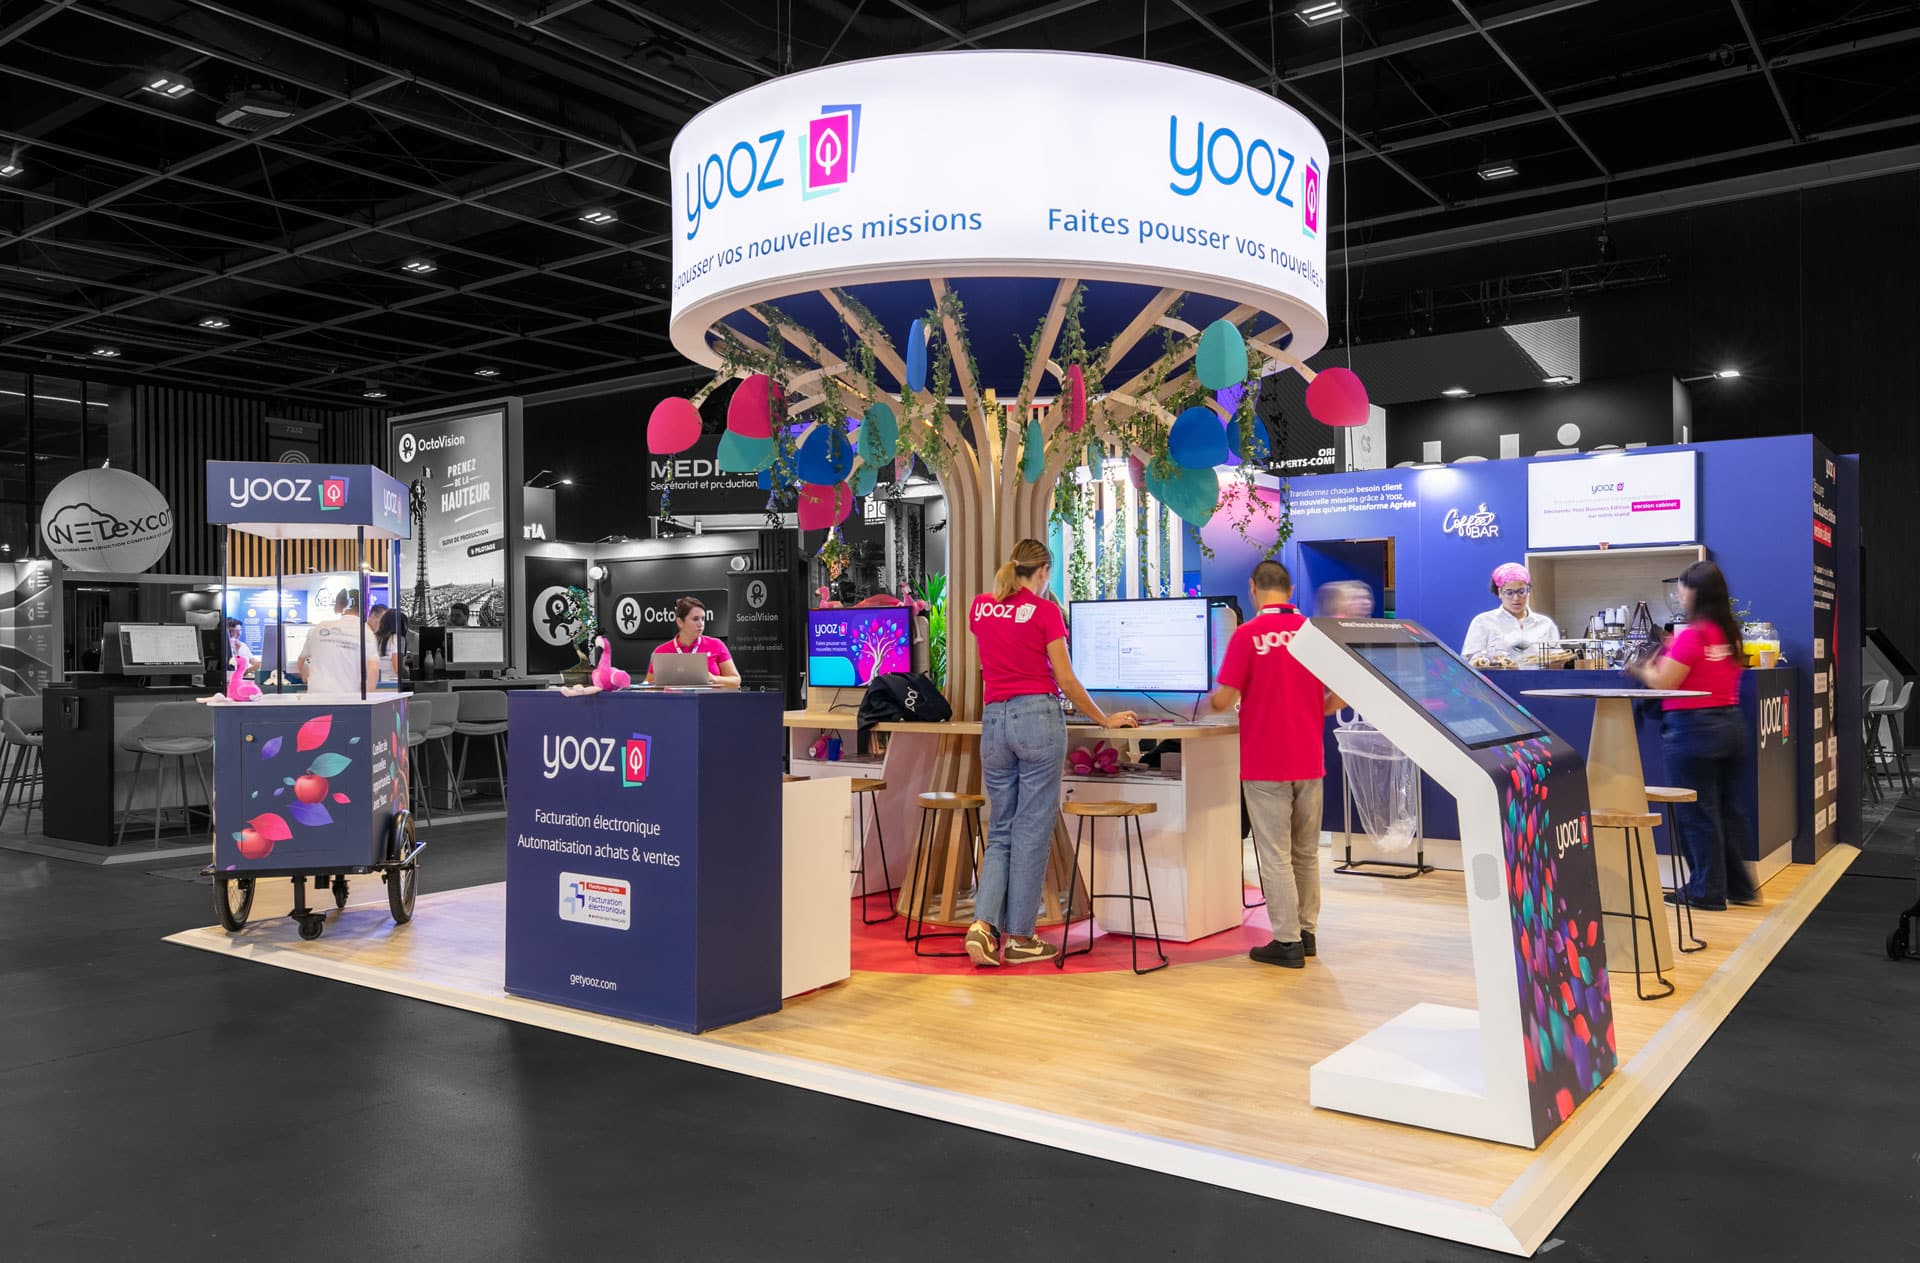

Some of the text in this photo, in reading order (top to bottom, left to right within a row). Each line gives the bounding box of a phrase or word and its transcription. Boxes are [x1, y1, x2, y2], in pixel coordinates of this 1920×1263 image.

[1169, 114, 1296, 208] yooz
[686, 129, 785, 241] yooz
[676, 254, 714, 297] pousser
[717, 245, 743, 269] vos
[748, 221, 853, 260] nouvelles
[861, 209, 983, 241] missions
[1048, 207, 1130, 237] Faites
[1139, 219, 1230, 251] pousser
[1236, 235, 1266, 261] vos
[1270, 246, 1320, 289] nouvelles
[418, 434, 465, 452] OctoVision
[447, 458, 477, 478] PRENEZ
[454, 475, 470, 488] DE LA
[700, 479, 709, 489] et
[1290, 483, 1403, 498] Transformez chaque besoin client
[1591, 482, 1615, 495] yooz
[229, 477, 312, 508] yooz
[383, 488, 397, 517] yooz
[441, 481, 491, 513] HAUTEUR
[1299, 497, 1330, 506] nouvelle
[1330, 495, 1358, 504] mission
[1359, 494, 1379, 503] grâce
[1289, 508, 1306, 516] bien
[1306, 507, 1322, 516] plus
[1348, 502, 1389, 512] Plateforme
[1656, 501, 1678, 509] cabinet
[1471, 525, 1499, 539] BAR
[736, 611, 779, 622] SocialVision
[974, 602, 1015, 622] yooz
[815, 623, 838, 637] yooz
[1760, 696, 1781, 749] yooz
[543, 734, 616, 779] yooz
[535, 808, 661, 838] Facturation électronique
[1556, 818, 1580, 859] yooz
[517, 834, 680, 867] Automatisation achats & ventes
[588, 895, 623, 907] Facturation
[570, 973, 617, 991] getyooz.com
